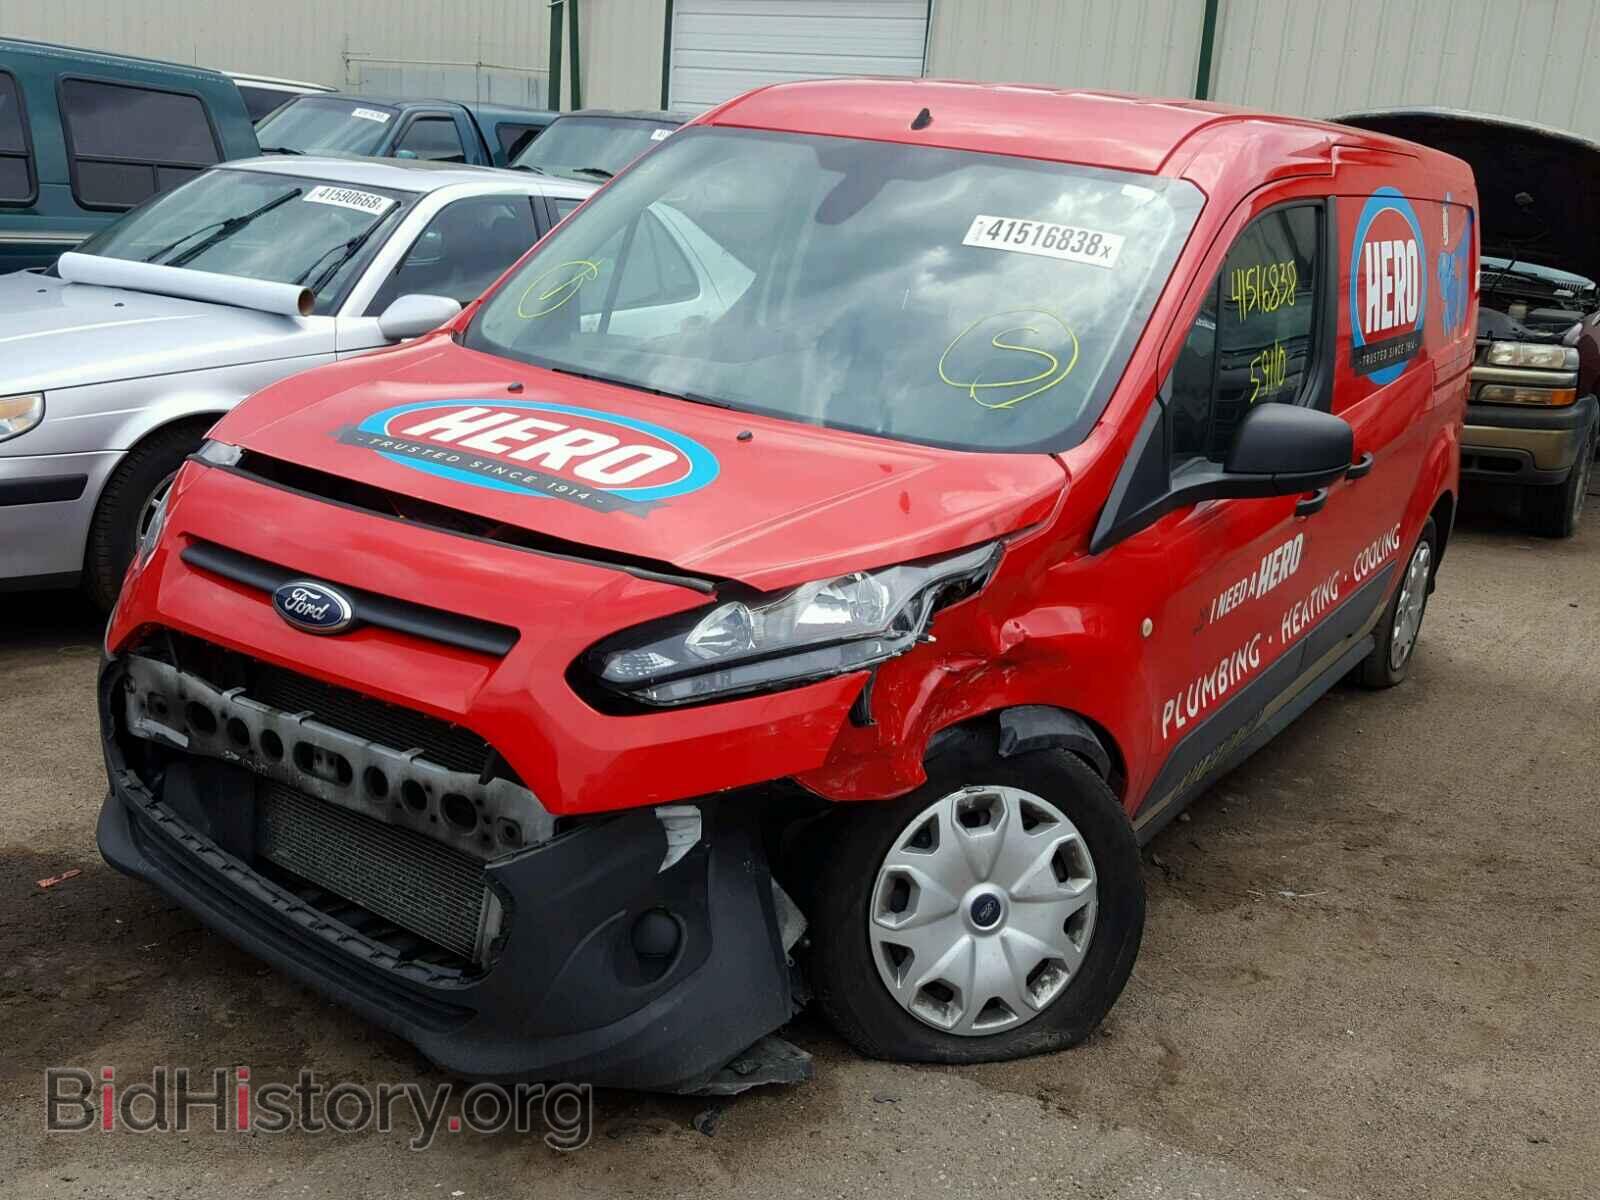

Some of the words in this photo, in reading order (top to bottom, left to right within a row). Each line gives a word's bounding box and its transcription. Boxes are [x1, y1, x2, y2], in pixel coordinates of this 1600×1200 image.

[1231, 260, 1297, 323] 41516838
[1365, 238, 1418, 335] HERO
[1362, 348, 1388, 367] TRUSTED
[1389, 343, 1405, 358] SINCE
[369, 438, 461, 462] TRUSTED
[469, 460, 538, 484] SINCE
[547, 482, 592, 500] 1914
[399, 406, 679, 485] HERO
[284, 587, 331, 620] Ford
[1209, 598, 1217, 625] I
[1216, 577, 1248, 620] NEED
[1247, 571, 1257, 598] A
[1256, 532, 1304, 600] HERO
[1162, 632, 1262, 740] PLUMBING
[1281, 570, 1340, 644] HEATING
[1353, 522, 1401, 582] COOLING
